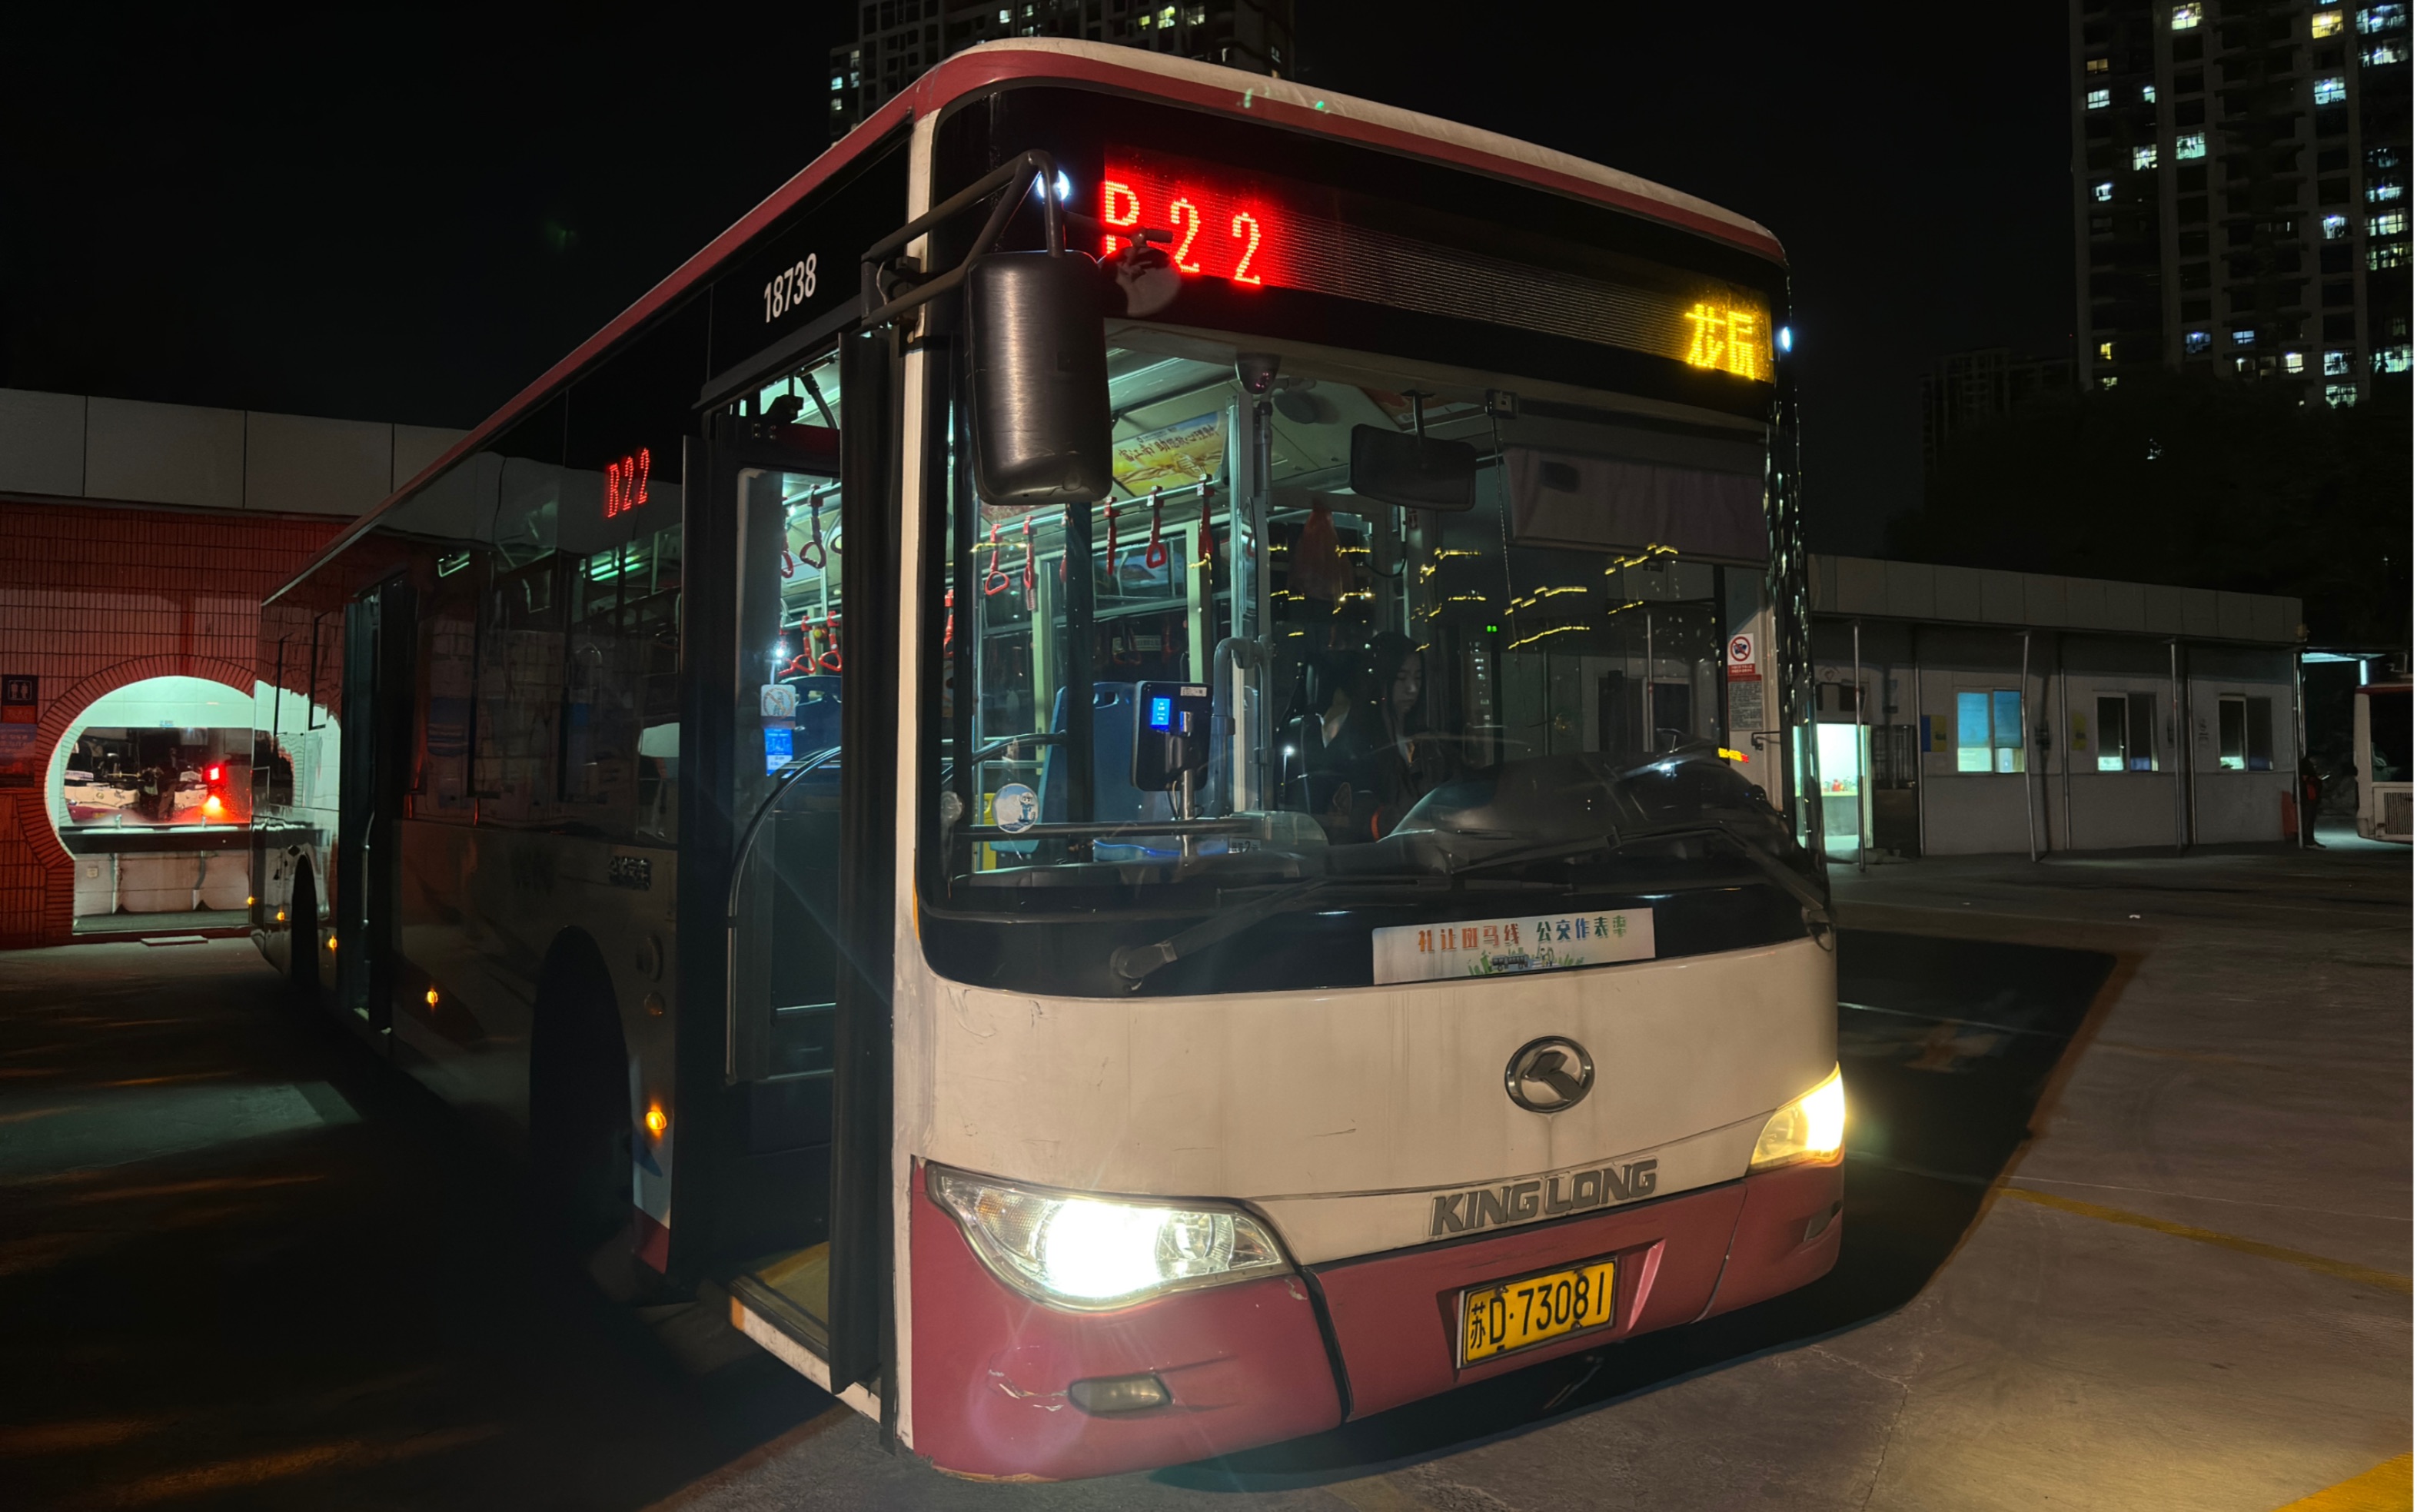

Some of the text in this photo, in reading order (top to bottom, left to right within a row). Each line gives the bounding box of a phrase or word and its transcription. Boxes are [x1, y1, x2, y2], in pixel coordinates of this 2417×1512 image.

[764, 252, 817, 324] 18738
[607, 447, 650, 517] B22
[1418, 915, 1627, 952] 礼让斑马线 公交作表率
[1430, 1158, 1658, 1236] KING LONG
[1470, 1271, 1605, 1351] 苏D·73081
